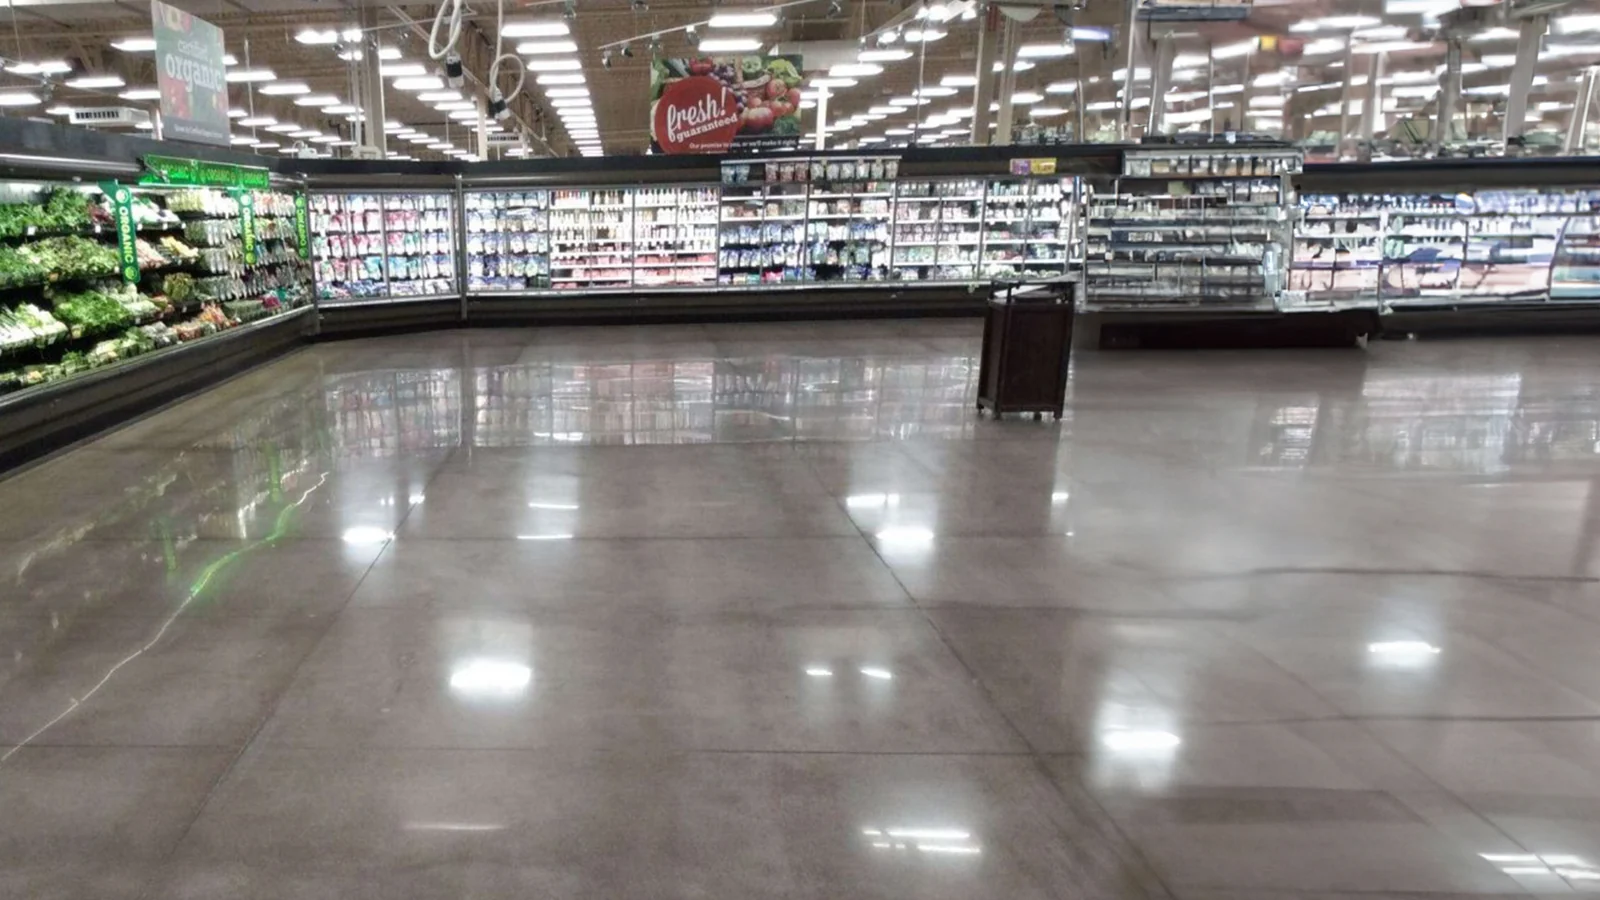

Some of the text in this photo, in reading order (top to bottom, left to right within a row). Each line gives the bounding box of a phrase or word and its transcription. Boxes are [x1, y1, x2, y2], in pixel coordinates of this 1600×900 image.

[165, 53, 222, 92] organic
[667, 86, 726, 142] fresh!
[676, 113, 738, 143] guaranteed
[119, 206, 134, 264] ORGANIC
[243, 207, 254, 251] ORGANIC
